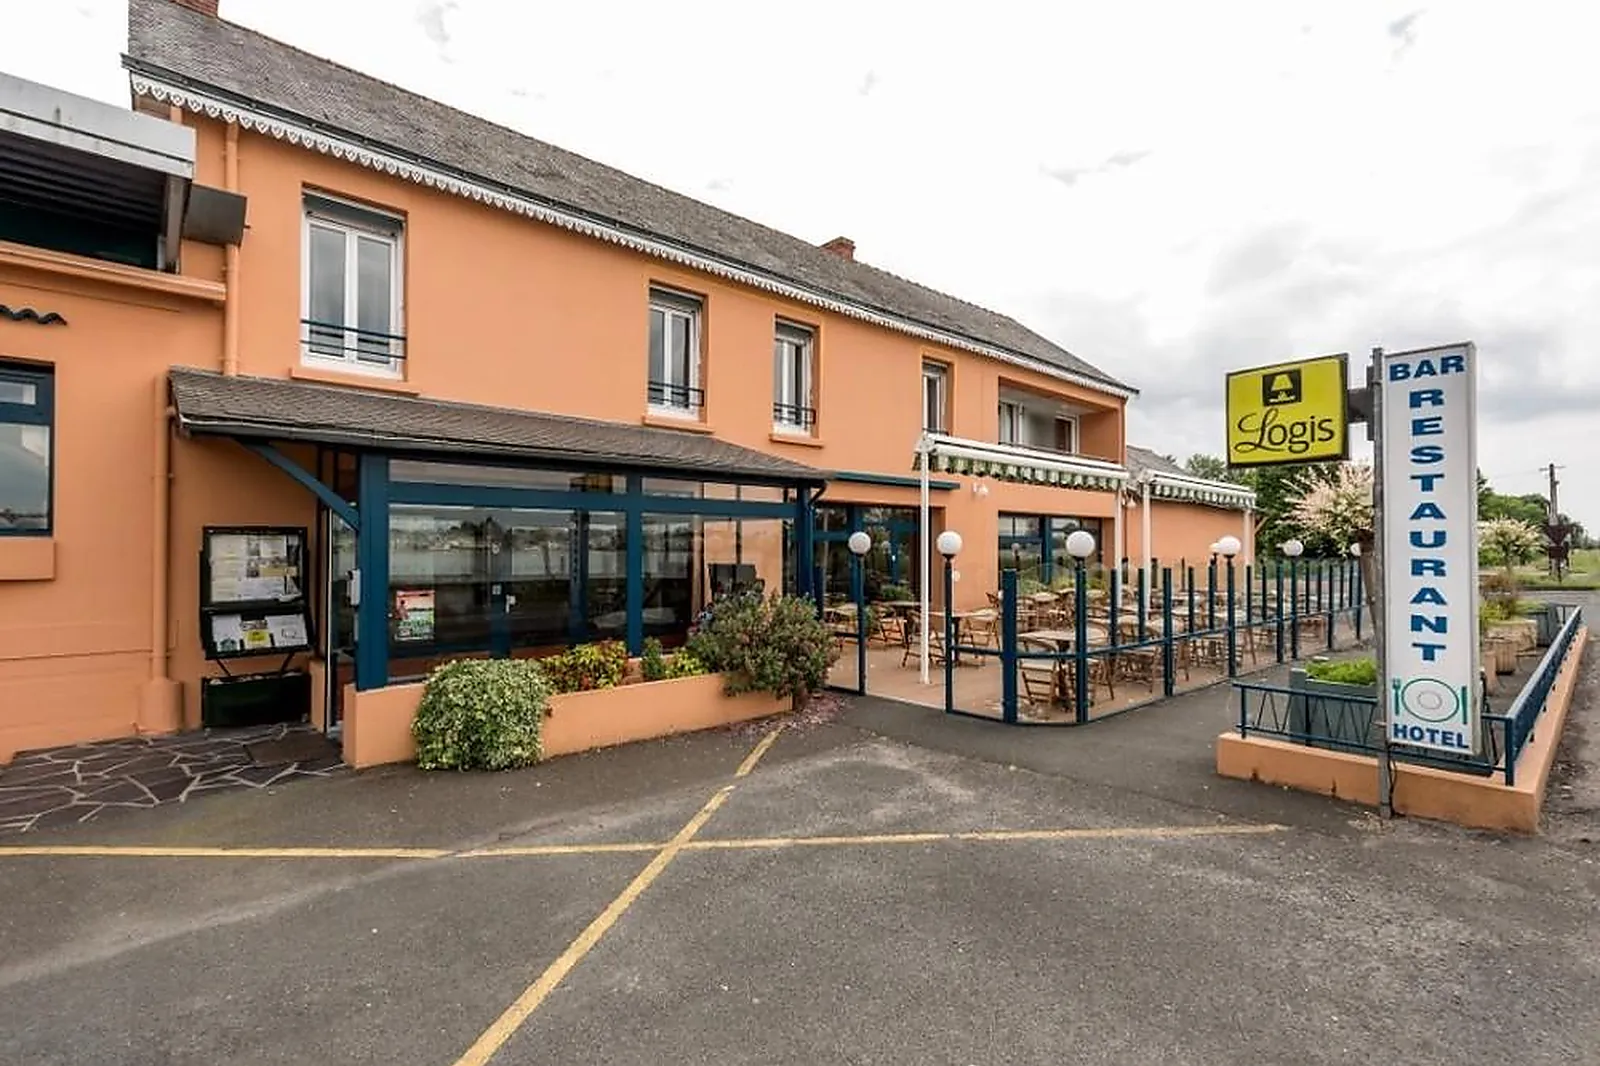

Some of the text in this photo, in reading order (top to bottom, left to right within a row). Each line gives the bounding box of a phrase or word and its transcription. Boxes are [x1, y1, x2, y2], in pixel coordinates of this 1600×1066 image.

[1389, 354, 1465, 382] BAR
[1234, 408, 1335, 454] Logis
[1408, 389, 1447, 663] RESTAURANT
[1393, 723, 1469, 749] HOTEL
